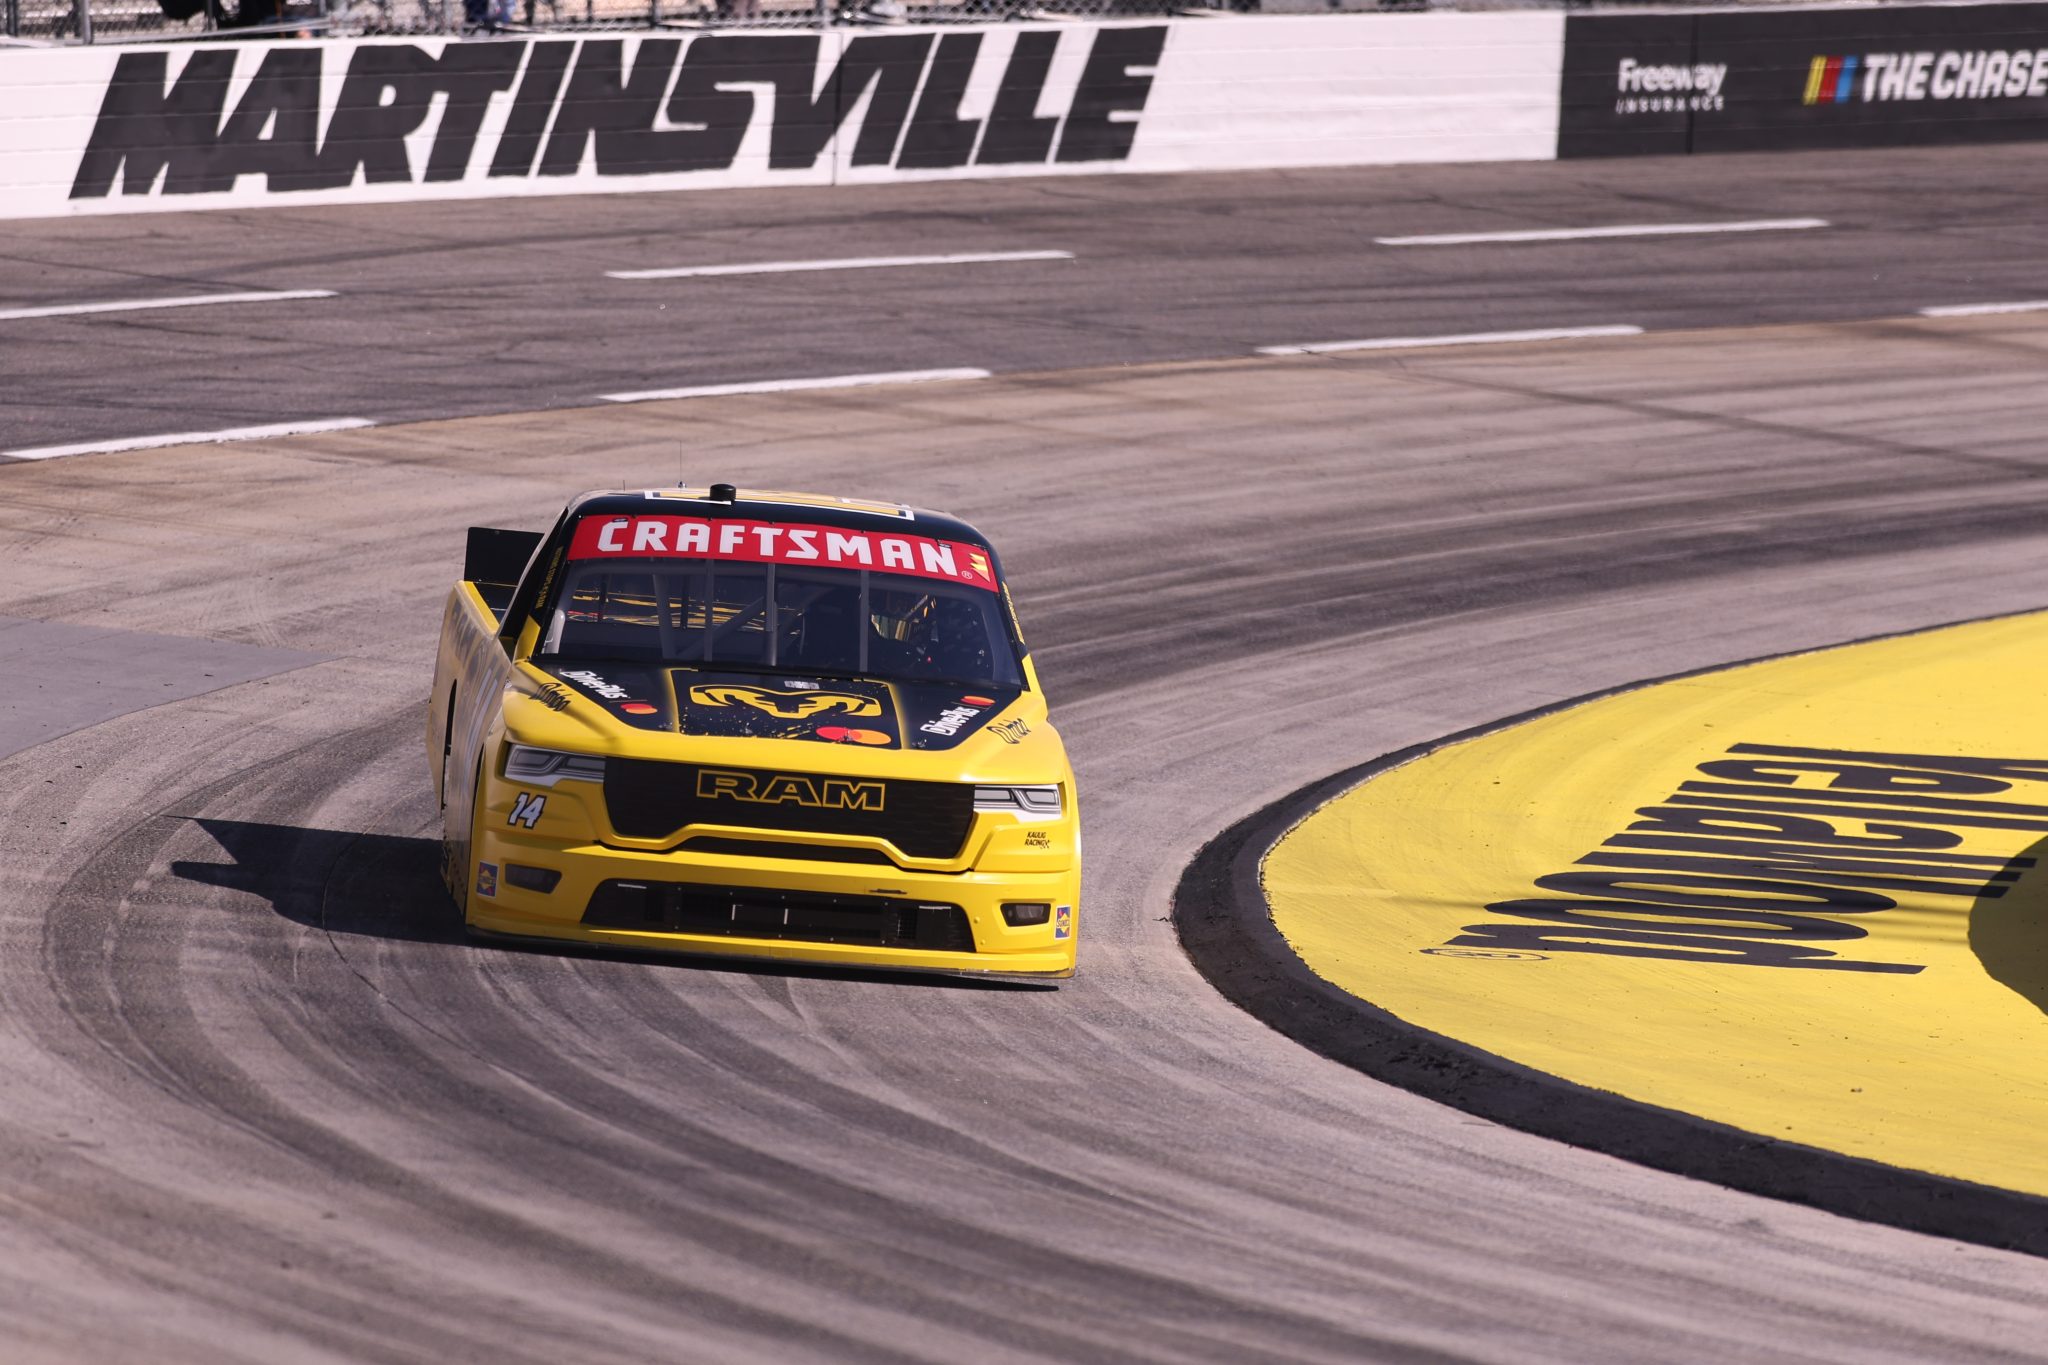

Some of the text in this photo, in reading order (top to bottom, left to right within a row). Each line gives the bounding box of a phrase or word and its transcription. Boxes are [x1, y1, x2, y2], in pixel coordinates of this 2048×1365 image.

[1618, 57, 1727, 96] Freeway
[1863, 49, 2048, 102] THE CHASE
[69, 25, 1168, 199] MARTINSVILLE
[1616, 95, 1725, 114] INSURANCE
[597, 520, 959, 576] CRAFTSMAN
[507, 792, 547, 829] 14
[696, 769, 886, 811] RAM
